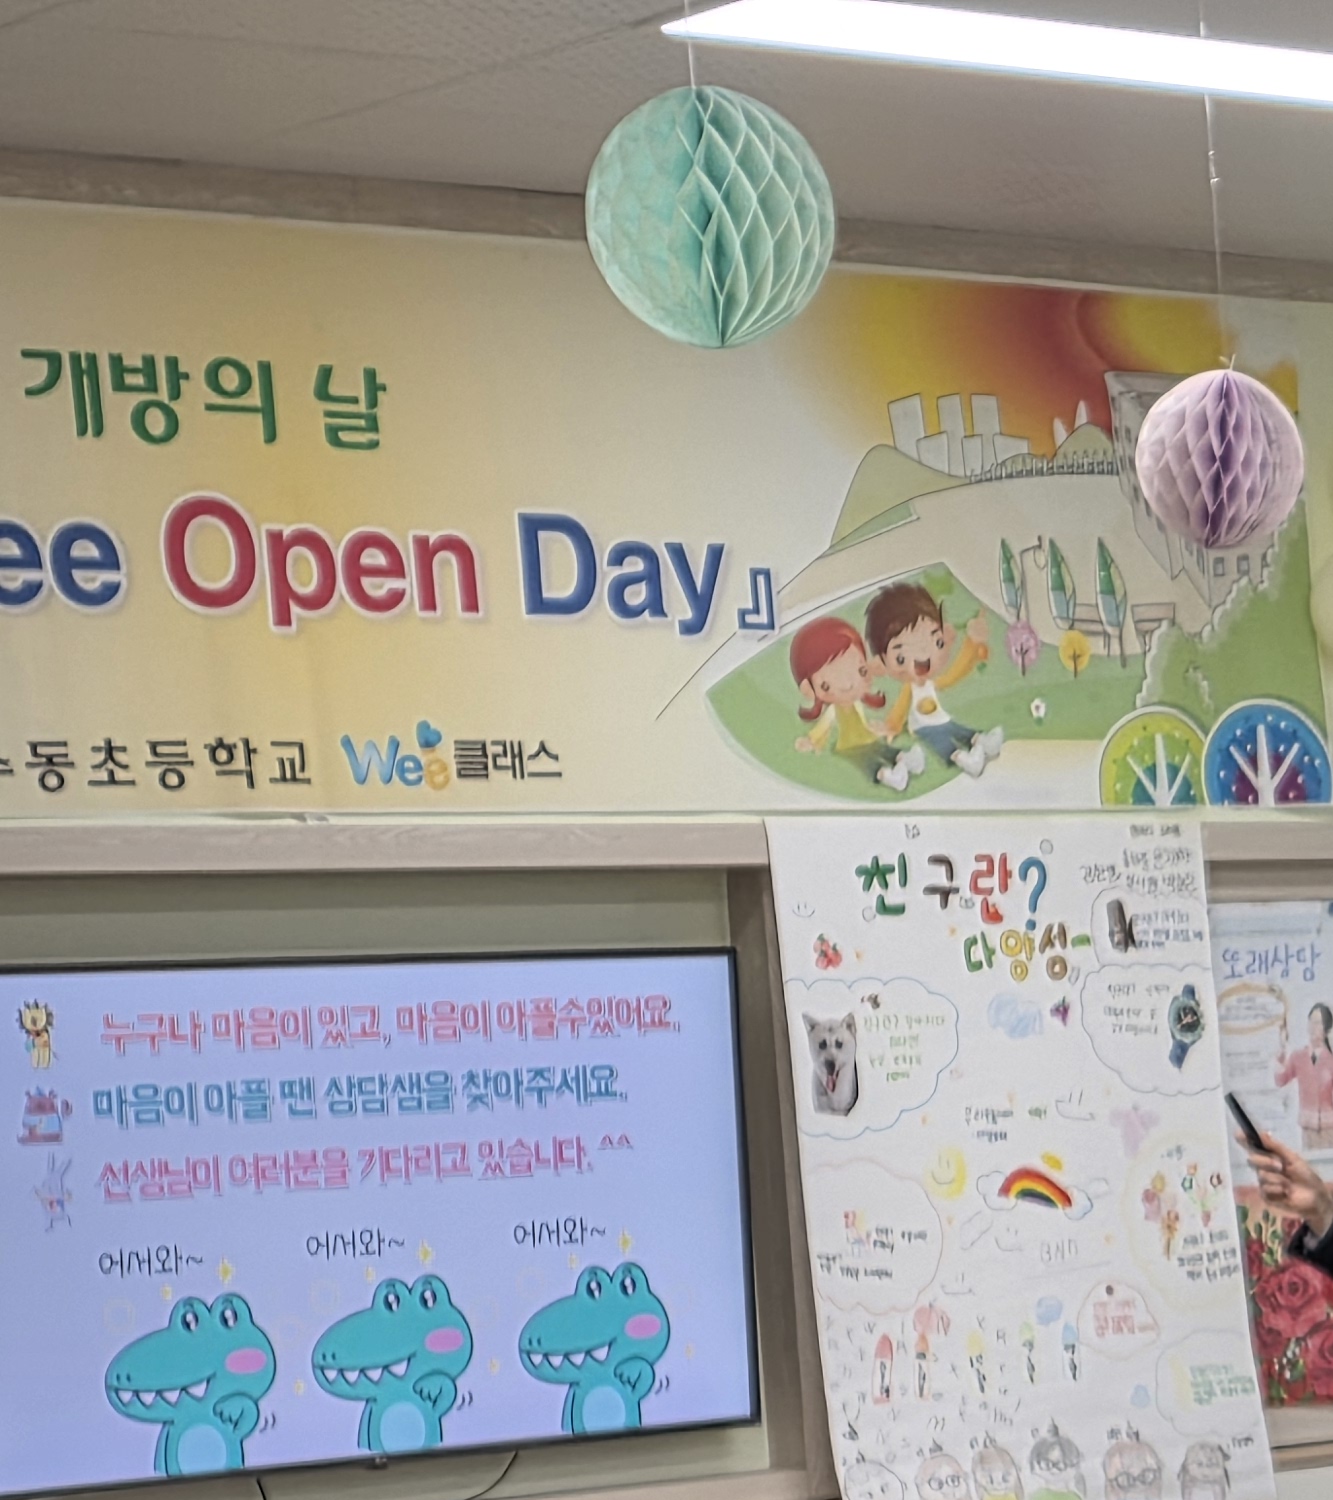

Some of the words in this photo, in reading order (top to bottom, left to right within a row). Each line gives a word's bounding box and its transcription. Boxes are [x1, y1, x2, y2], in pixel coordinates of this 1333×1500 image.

[20, 347, 277, 445] 개방의
[313, 363, 388, 450] 날
[162, 495, 481, 628] Open
[0, 737, 312, 792] 동초등학교
[855, 852, 1047, 931] 친구란?
[101, 1010, 204, 1056] 누구나
[212, 1005, 313, 1052] 마음이
[316, 1004, 391, 1049] 있고,
[396, 1000, 492, 1045] 마음이
[93, 1082, 199, 1130] 마음이
[204, 1077, 272, 1124] 아플
[279, 1076, 317, 1120] 땐
[323, 1069, 456, 1117] 상담샘을
[461, 1064, 628, 1114] 찾아주세요.
[96, 1154, 223, 1204] 선생님이
[228, 1147, 350, 1194] 여러분을
[357, 1142, 473, 1187] 기다리고
[478, 1135, 594, 1181] 있습니다.
